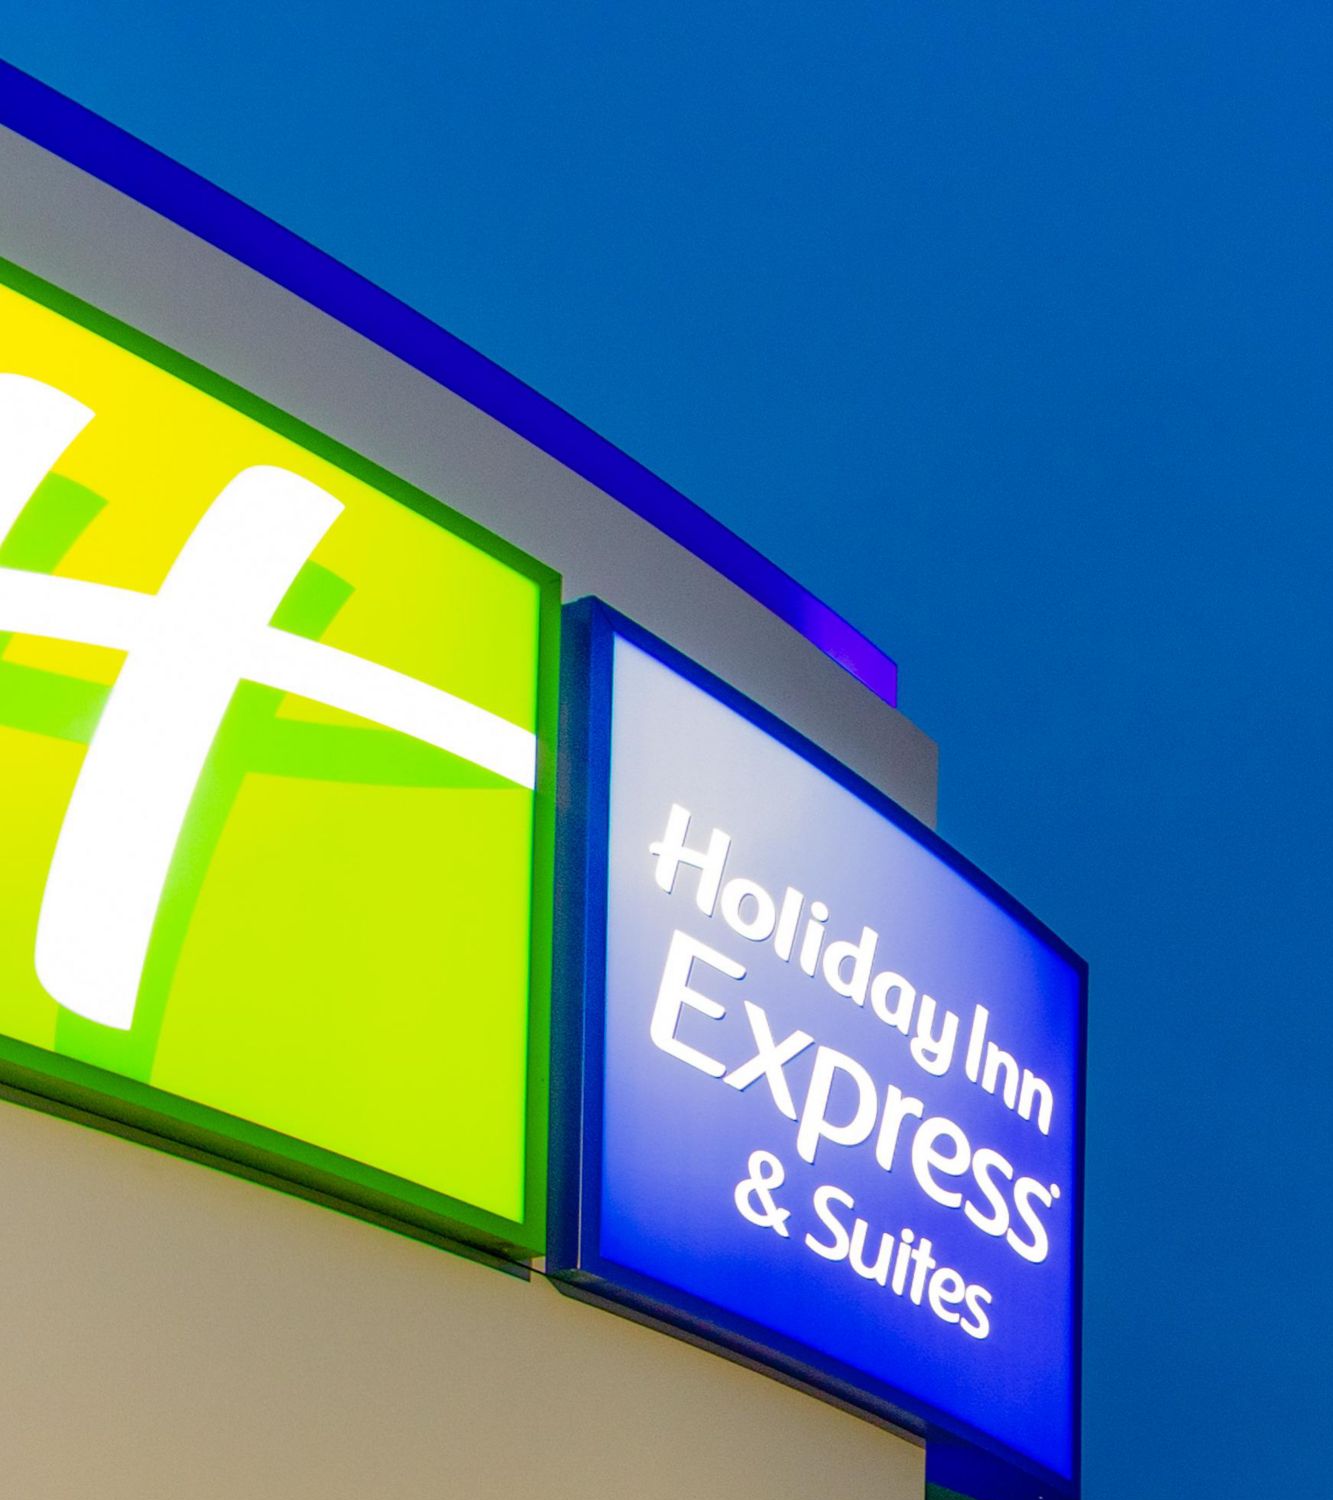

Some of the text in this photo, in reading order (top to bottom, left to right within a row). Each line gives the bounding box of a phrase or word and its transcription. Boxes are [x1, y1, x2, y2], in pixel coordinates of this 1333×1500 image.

[648, 803, 1053, 1135] Holiday Inn
[650, 929, 1053, 1263] Express
[734, 1150, 992, 1339] & Suites
